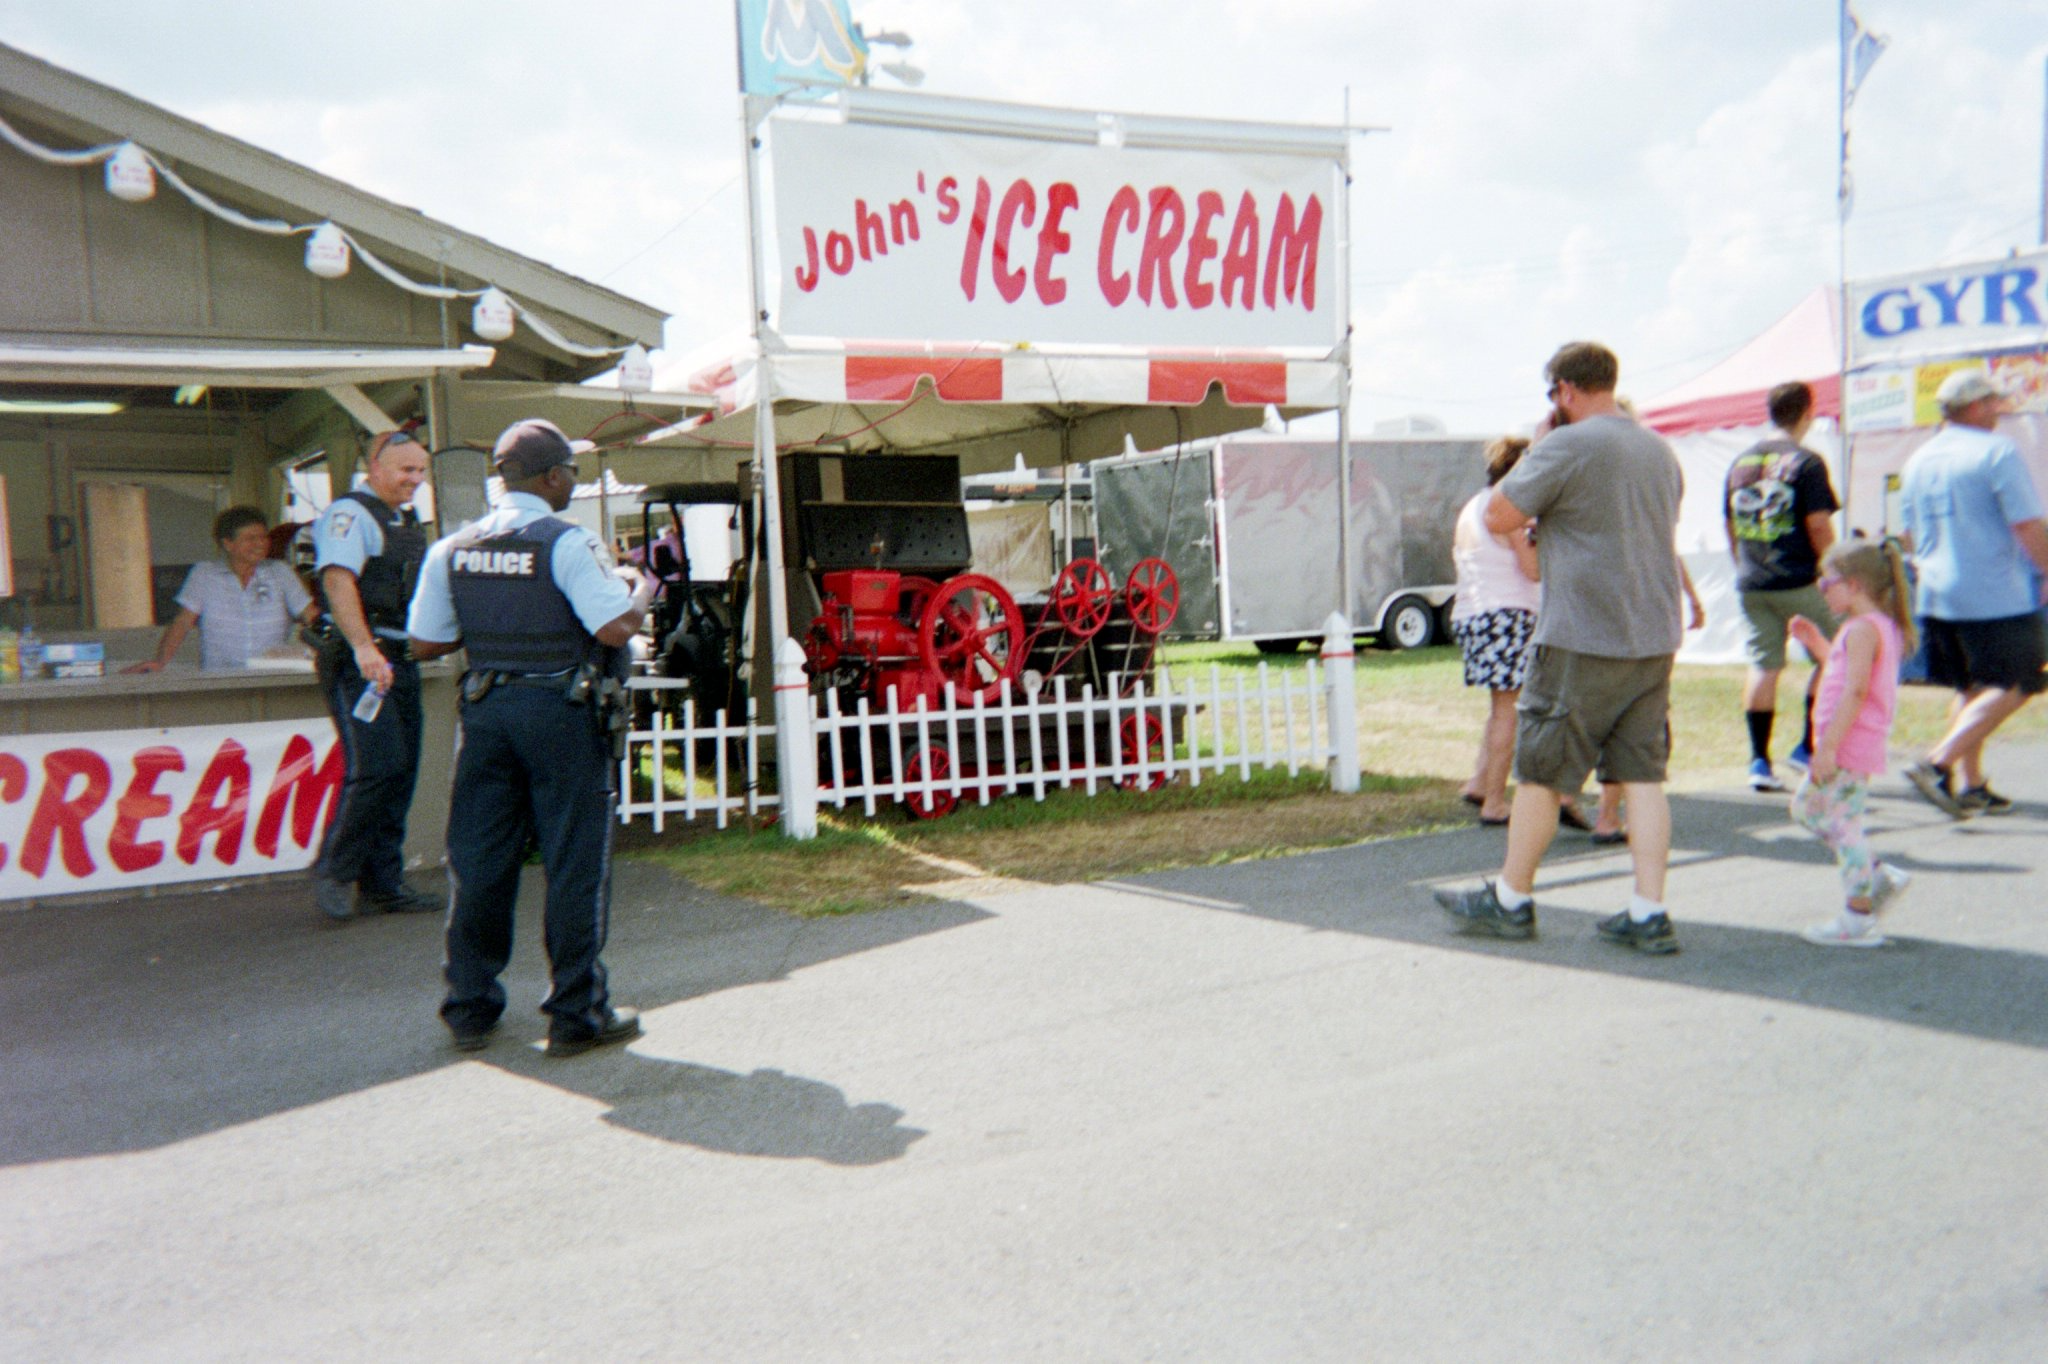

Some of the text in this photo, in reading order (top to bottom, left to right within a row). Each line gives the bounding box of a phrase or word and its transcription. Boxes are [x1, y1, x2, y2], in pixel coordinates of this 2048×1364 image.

[795, 169, 1323, 312] John's ICE CREAM
[1861, 266, 2048, 339] GYR
[452, 549, 534, 576] POLICE
